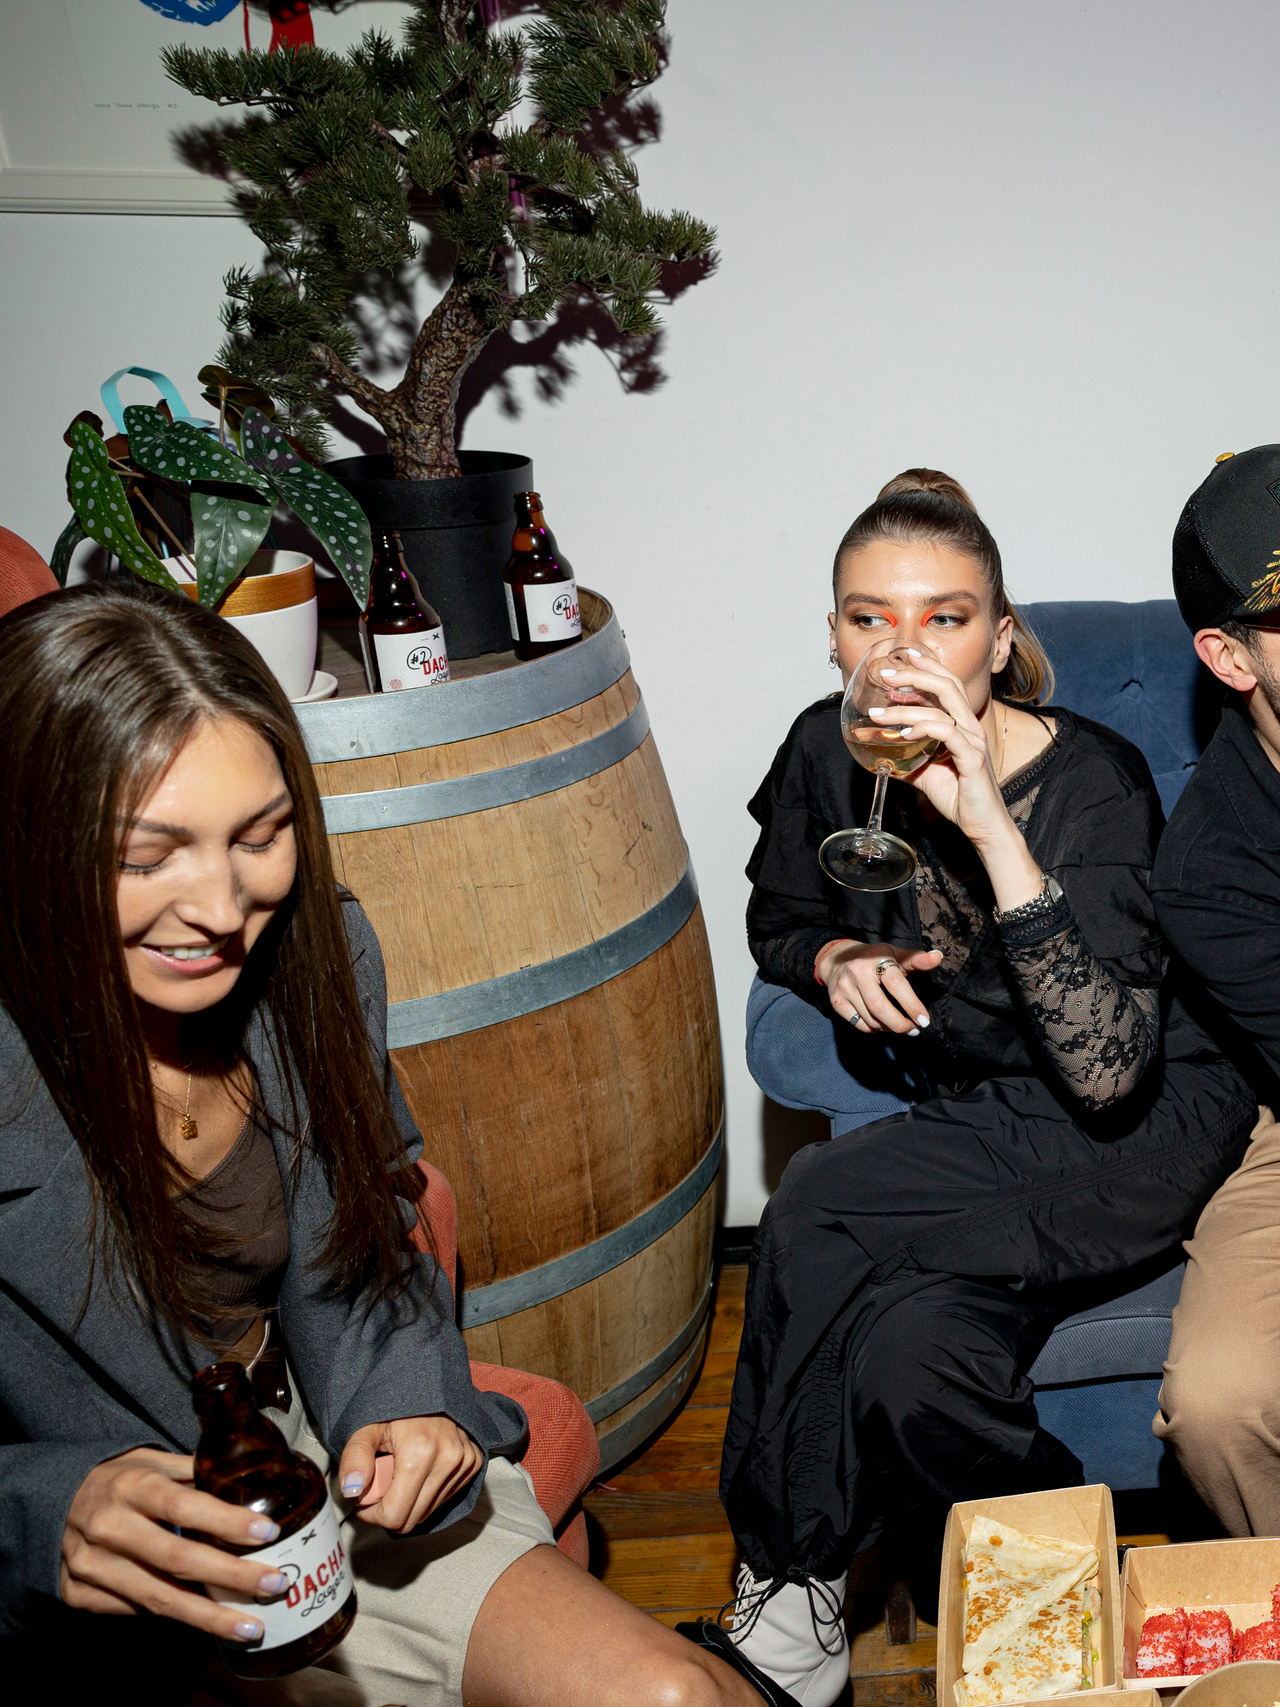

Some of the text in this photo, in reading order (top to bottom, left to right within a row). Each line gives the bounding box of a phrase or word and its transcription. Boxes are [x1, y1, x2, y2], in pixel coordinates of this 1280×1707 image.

[556, 597, 570, 611] #2
[410, 650, 430, 665] #2
[285, 1541, 345, 1609] DACHA
[301, 1569, 345, 1617] Lager
